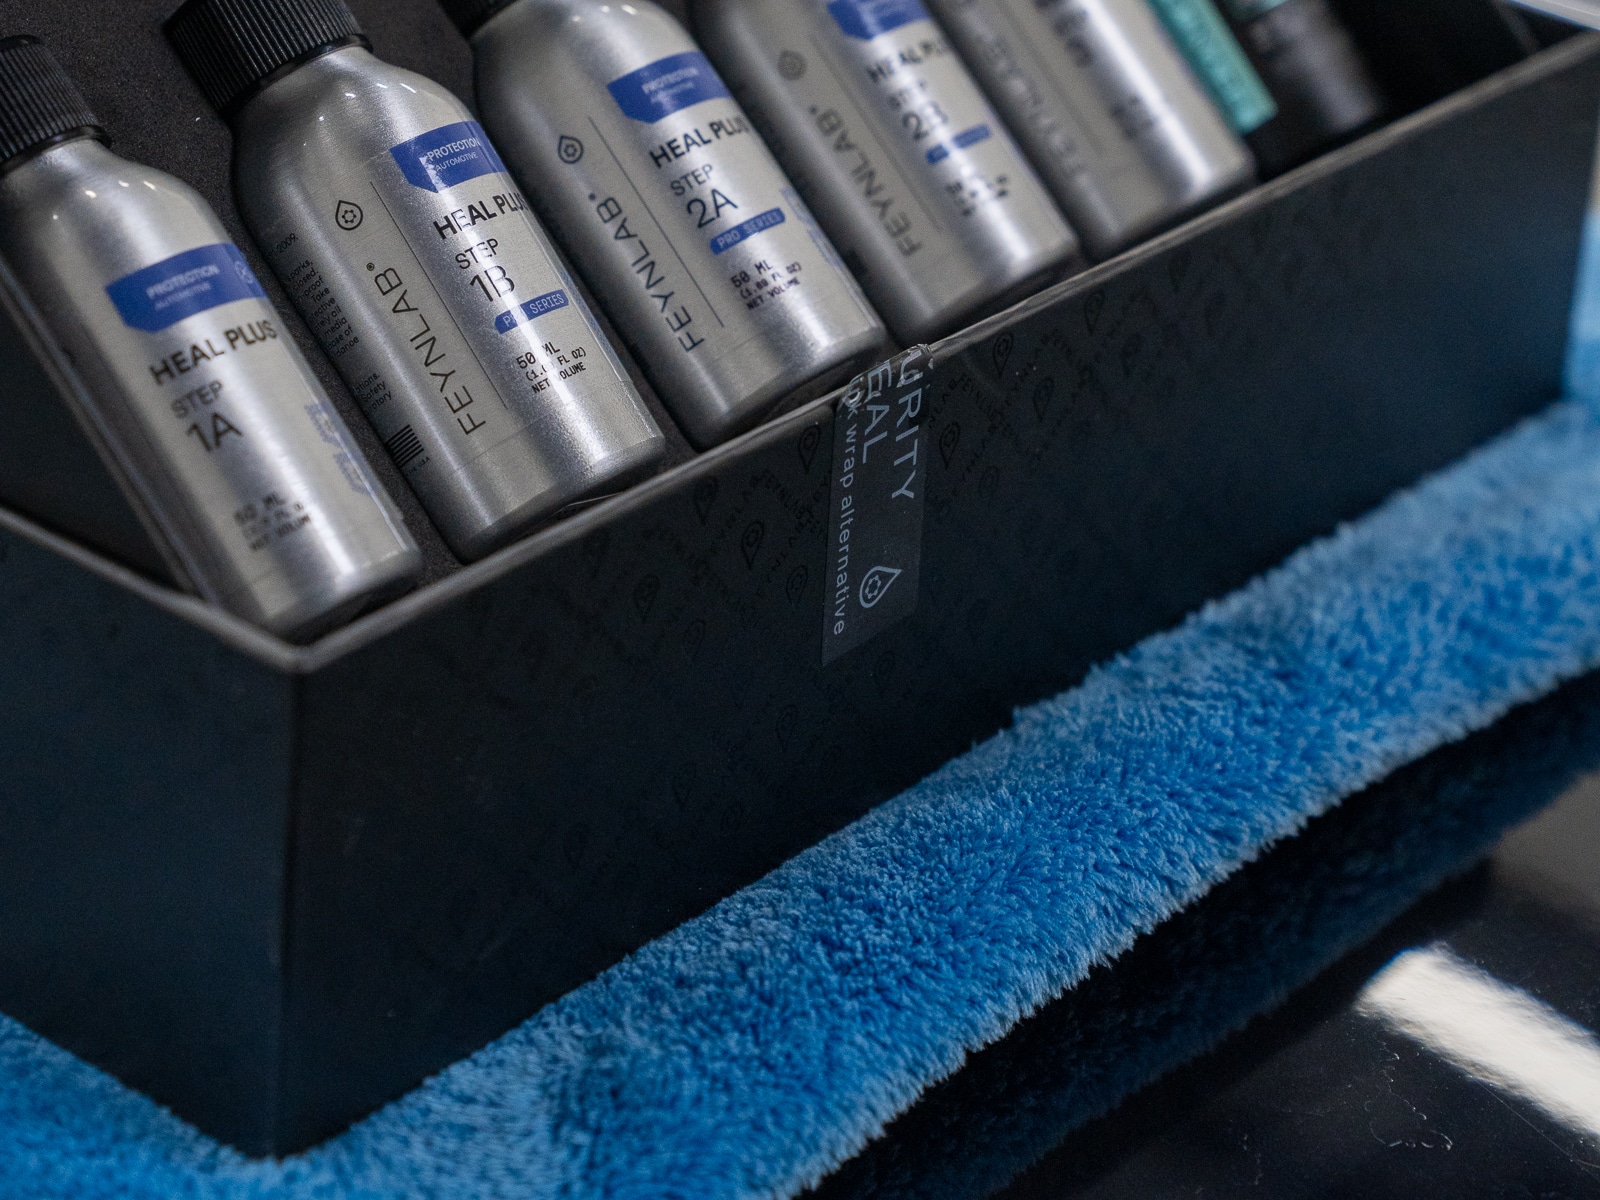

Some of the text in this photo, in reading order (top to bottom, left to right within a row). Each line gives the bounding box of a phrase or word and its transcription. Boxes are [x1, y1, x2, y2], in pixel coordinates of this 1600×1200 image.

[427, 137, 480, 162] PROTECTION
[436, 151, 478, 173] AUTOMOTIVE
[649, 128, 712, 169] HEAL
[670, 163, 713, 197] STEP
[433, 201, 497, 240] HEAL
[686, 188, 739, 229] 2A
[717, 211, 782, 249] PRO SERIES
[455, 238, 499, 270] STEP
[754, 259, 774, 275] ML
[311, 287, 330, 303] Take
[469, 265, 515, 302] 1B
[746, 276, 801, 311] NET VOLUME
[529, 293, 565, 314] SERIES
[150, 319, 278, 386] HEAL PLUS
[516, 351, 537, 370] 50
[557, 355, 570, 366] FL
[571, 346, 587, 359] OZ)
[531, 361, 586, 394] NET OLUME
[170, 380, 224, 419] STEP
[186, 411, 243, 452] 1A
[840, 423, 857, 488] wrap
[833, 495, 855, 636] alternative
